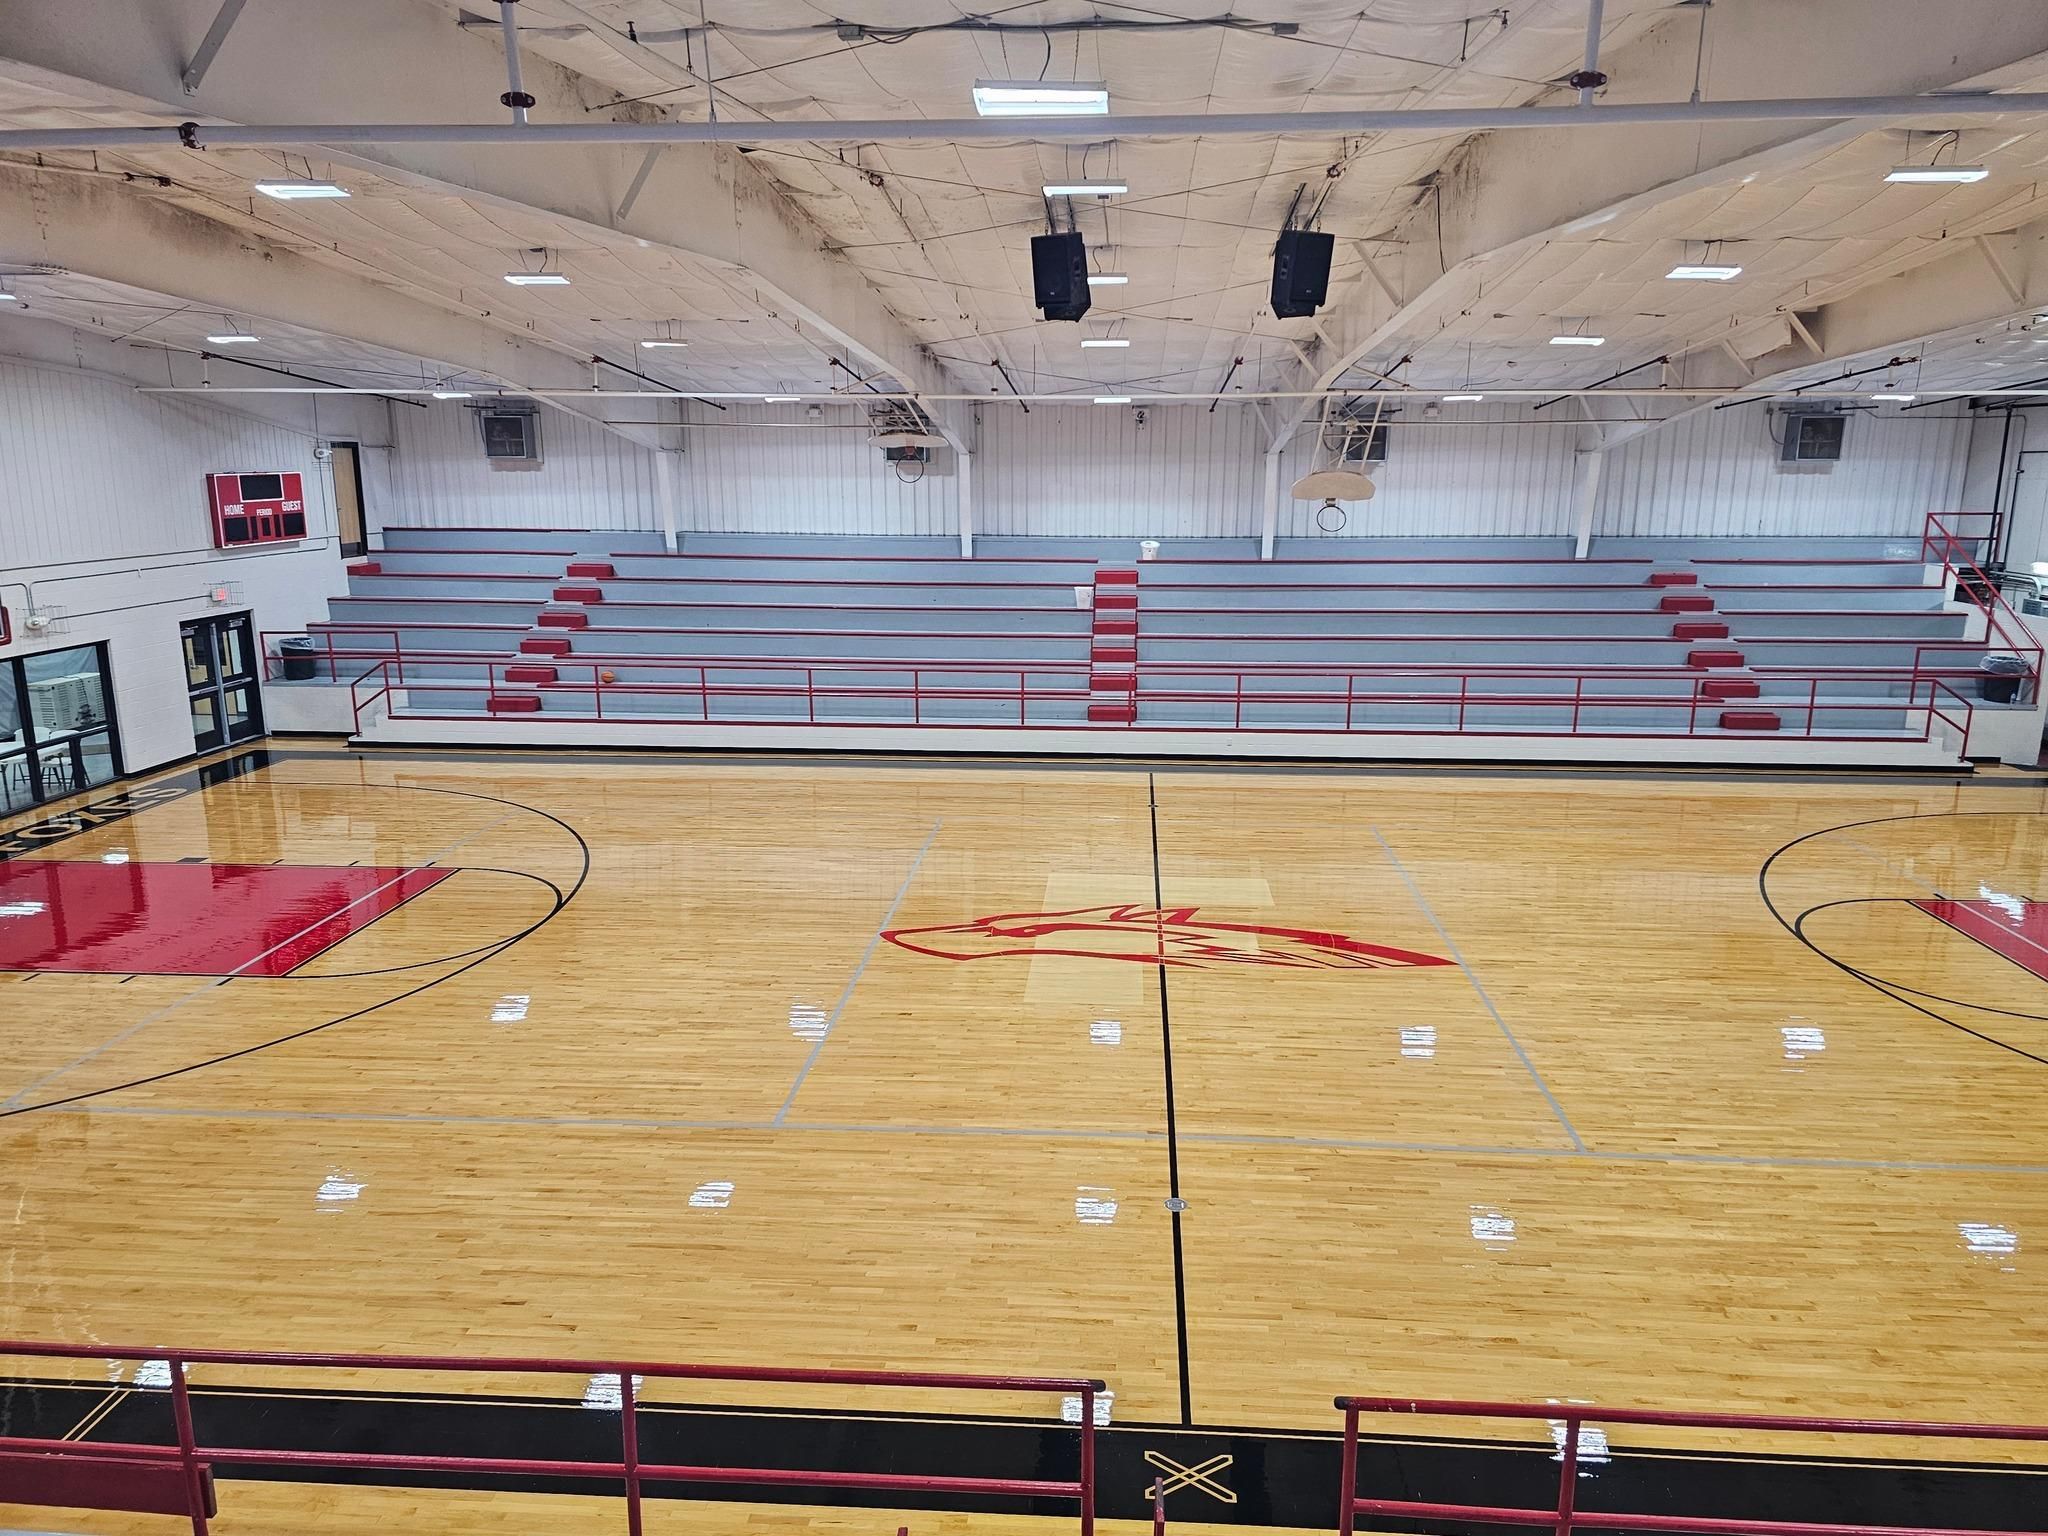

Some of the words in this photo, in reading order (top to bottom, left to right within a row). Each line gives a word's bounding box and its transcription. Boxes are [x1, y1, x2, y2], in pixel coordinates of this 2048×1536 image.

[224, 504, 245, 516] HOME
[281, 500, 302, 512] GUEST
[256, 508, 273, 517] PERIOD
